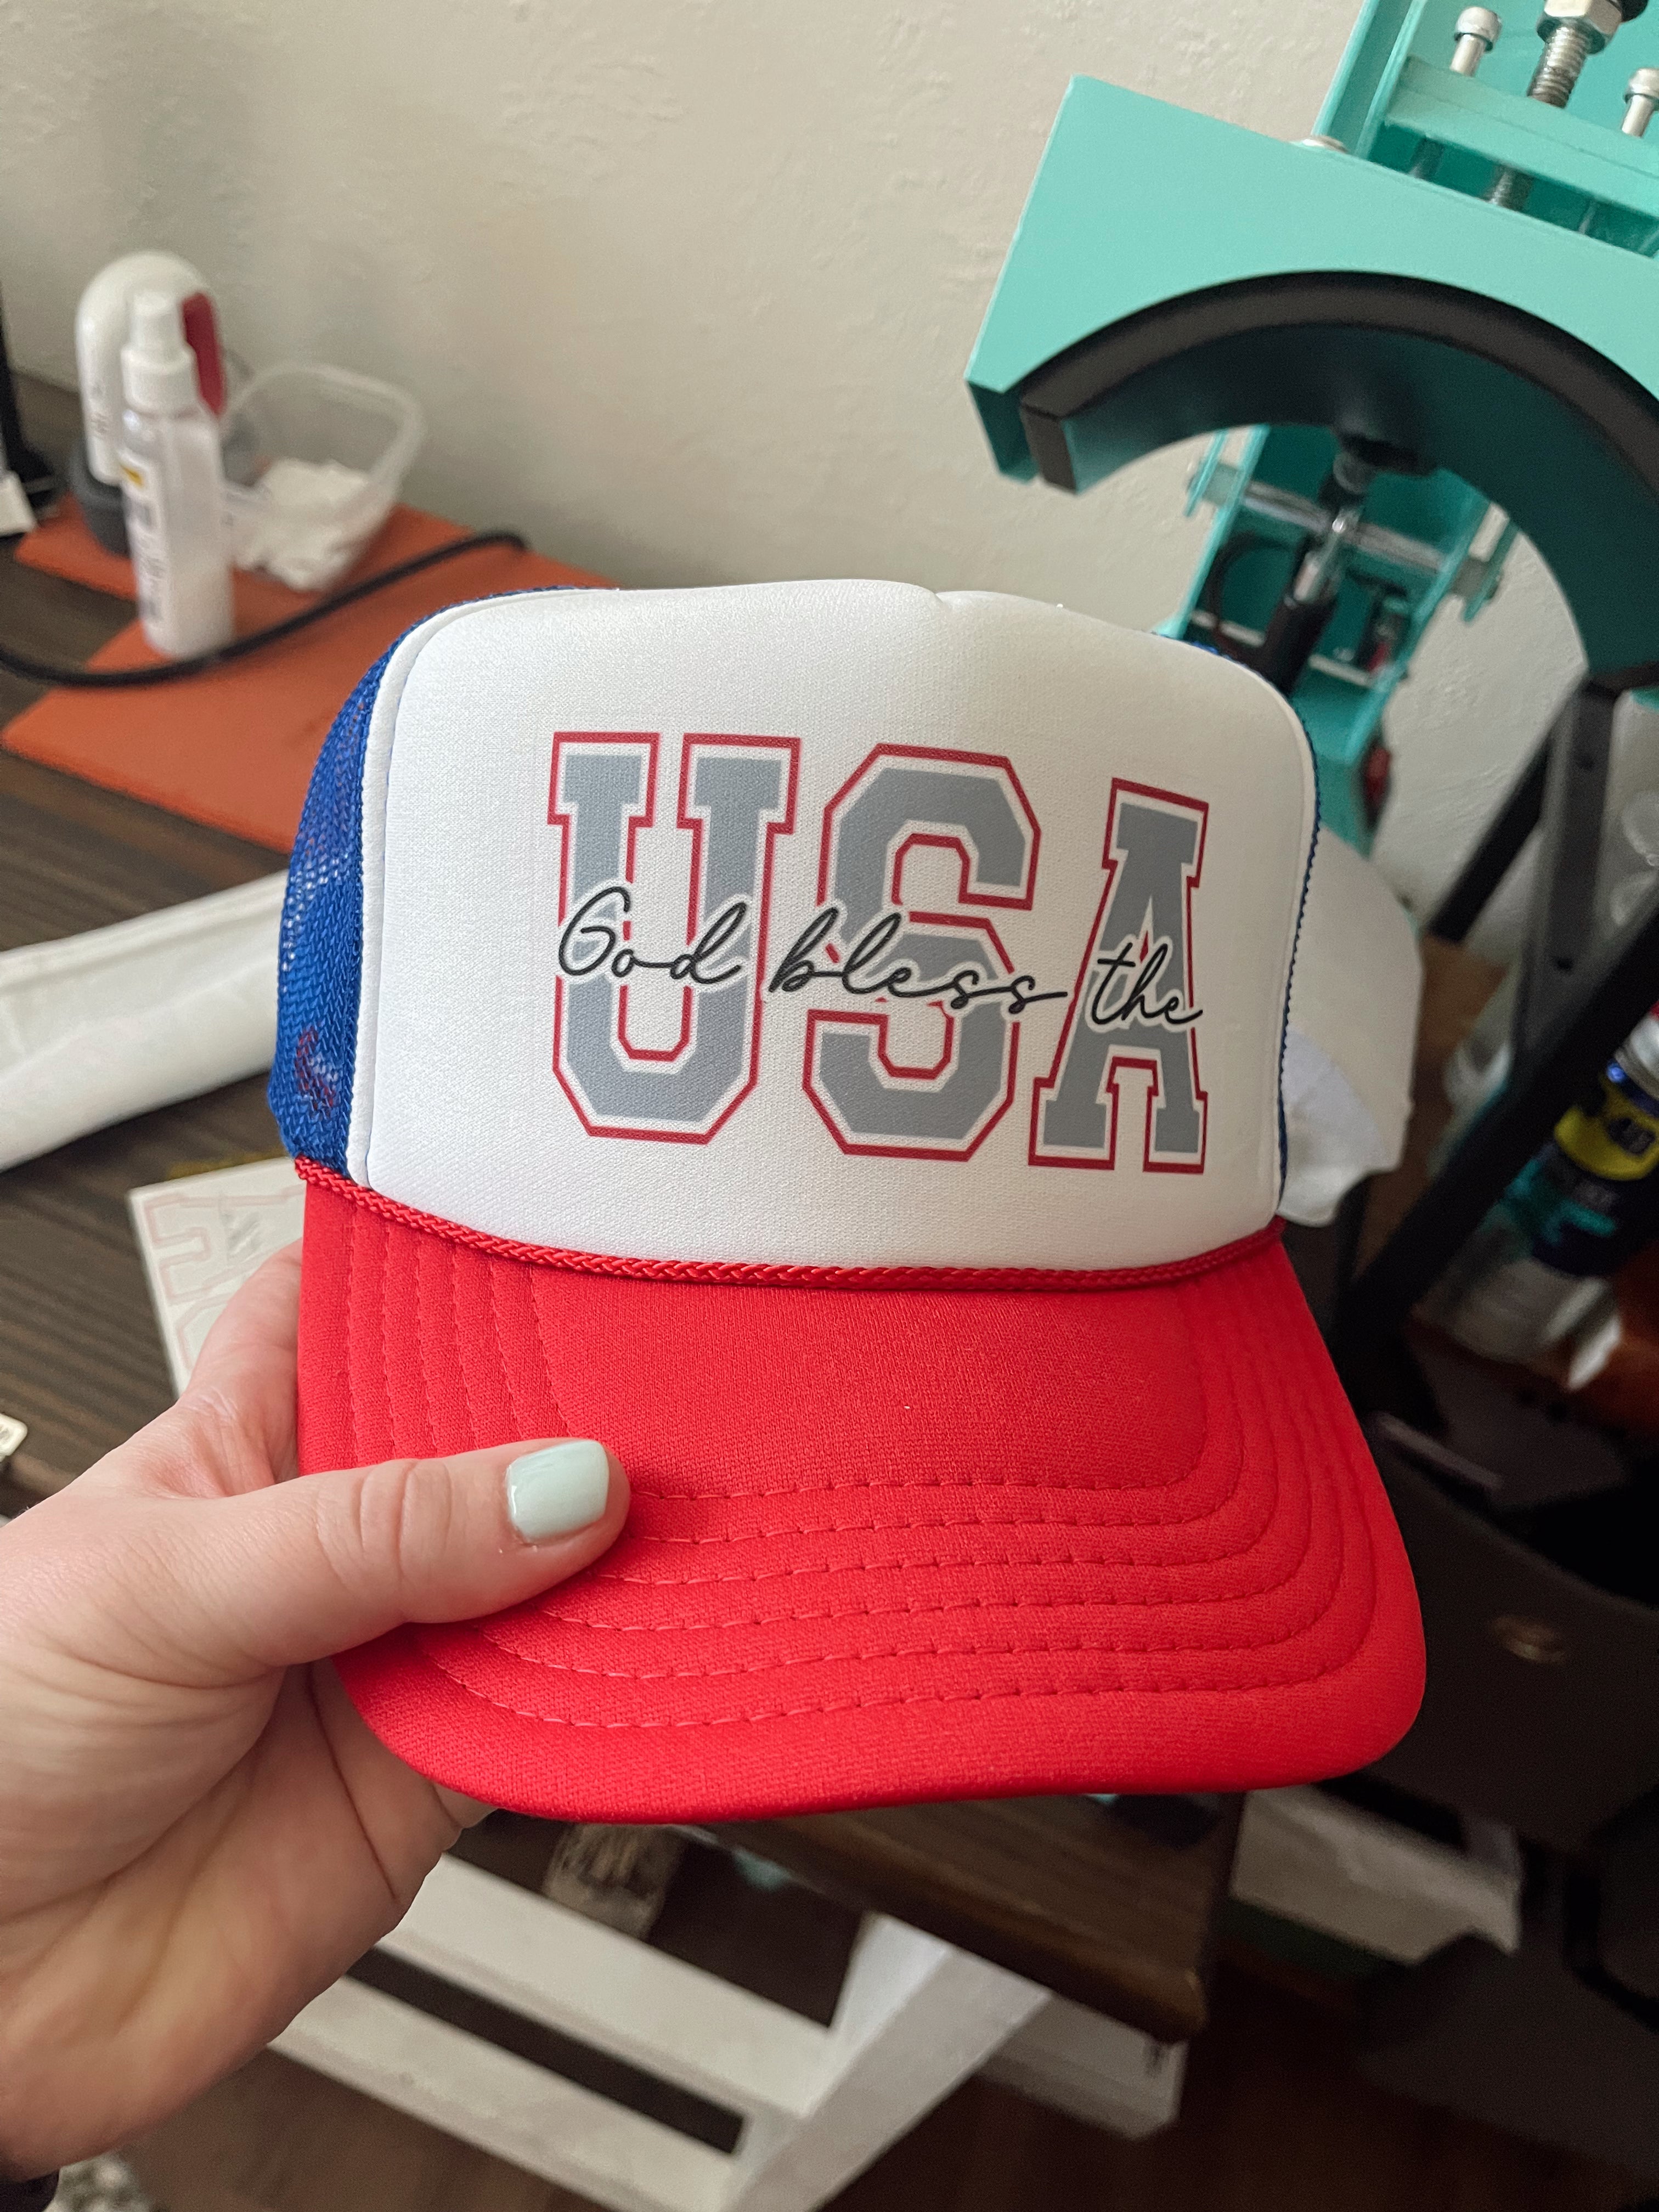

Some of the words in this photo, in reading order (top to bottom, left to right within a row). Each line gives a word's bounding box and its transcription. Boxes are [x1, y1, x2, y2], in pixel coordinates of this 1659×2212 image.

[547, 731, 1209, 1174] USA
[557, 886, 747, 985] God
[768, 906, 1069, 1014] bless
[1089, 942, 1204, 1026] the
